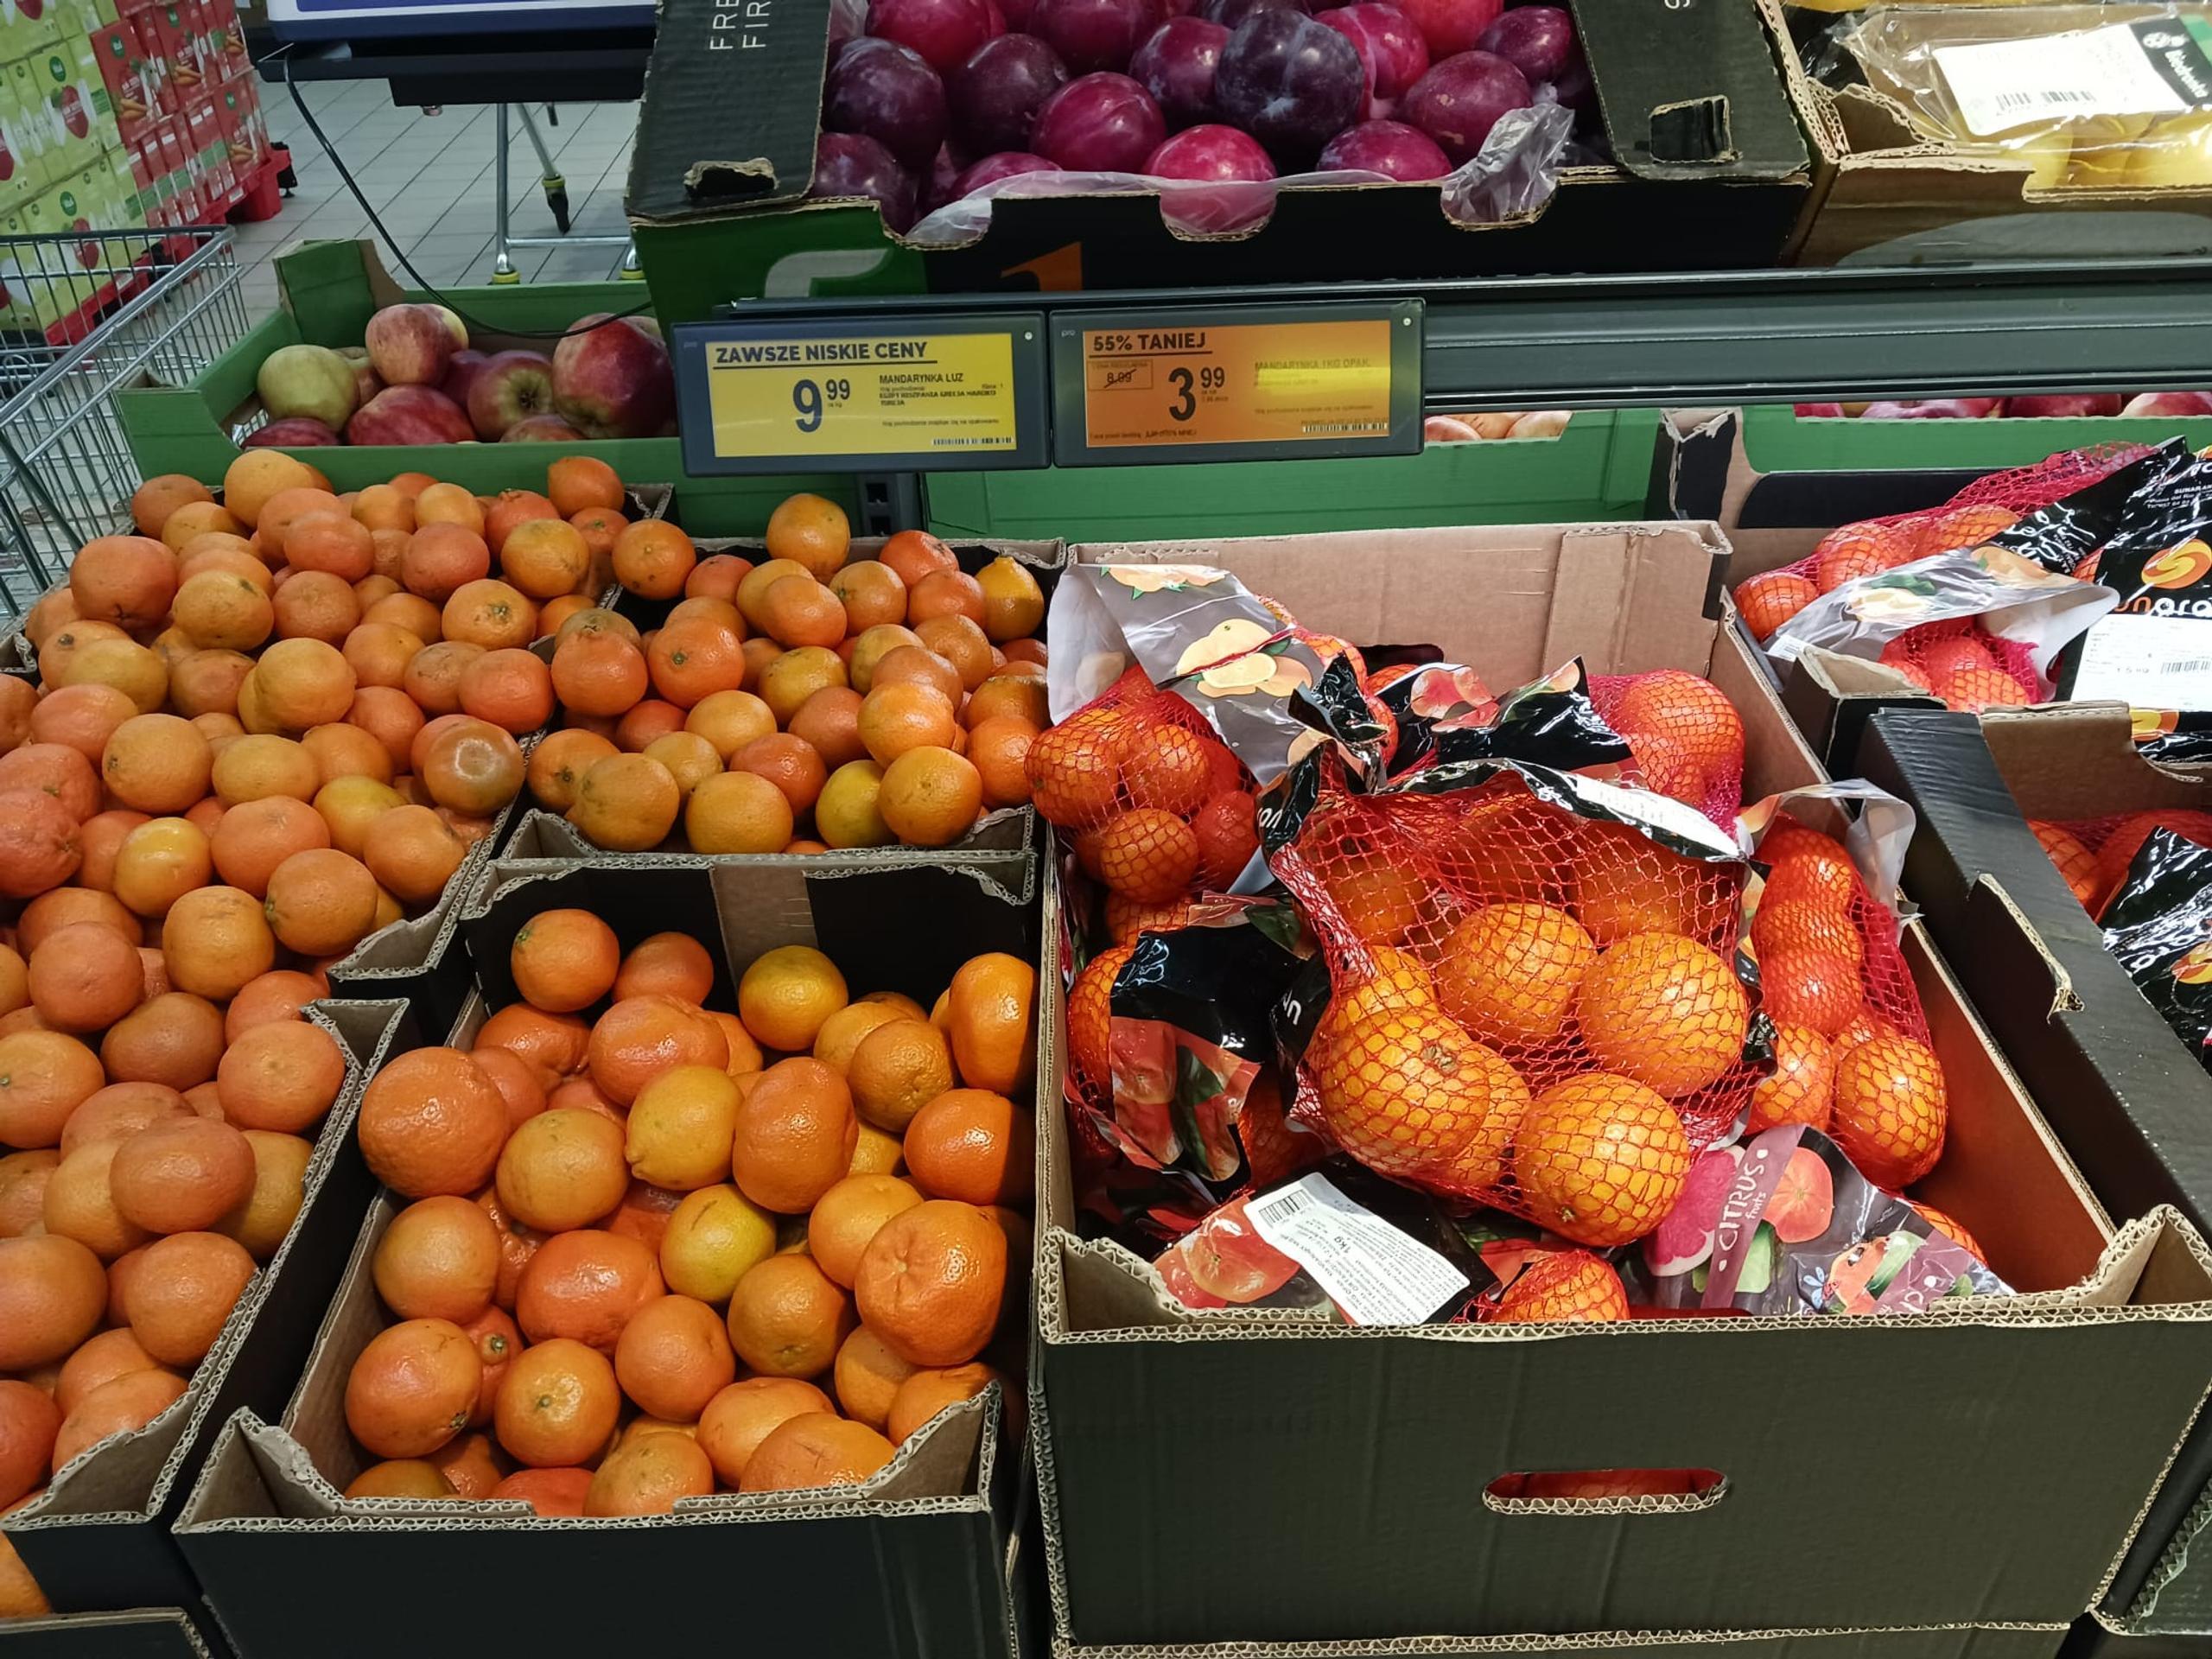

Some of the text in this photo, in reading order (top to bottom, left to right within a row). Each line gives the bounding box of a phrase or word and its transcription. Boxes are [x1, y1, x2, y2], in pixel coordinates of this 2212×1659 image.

[715, 341, 928, 364] ZAWSZE NISKIE CENY
[1093, 332, 1206, 351] 55% TANIEJ
[879, 372, 964, 385] MANDARYNKA LUZ
[792, 378, 851, 433] 9 99
[1167, 366, 1225, 421] 3 99
[1719, 1162, 1764, 1251] CITRUS
[1745, 1192, 1766, 1219] fruits
